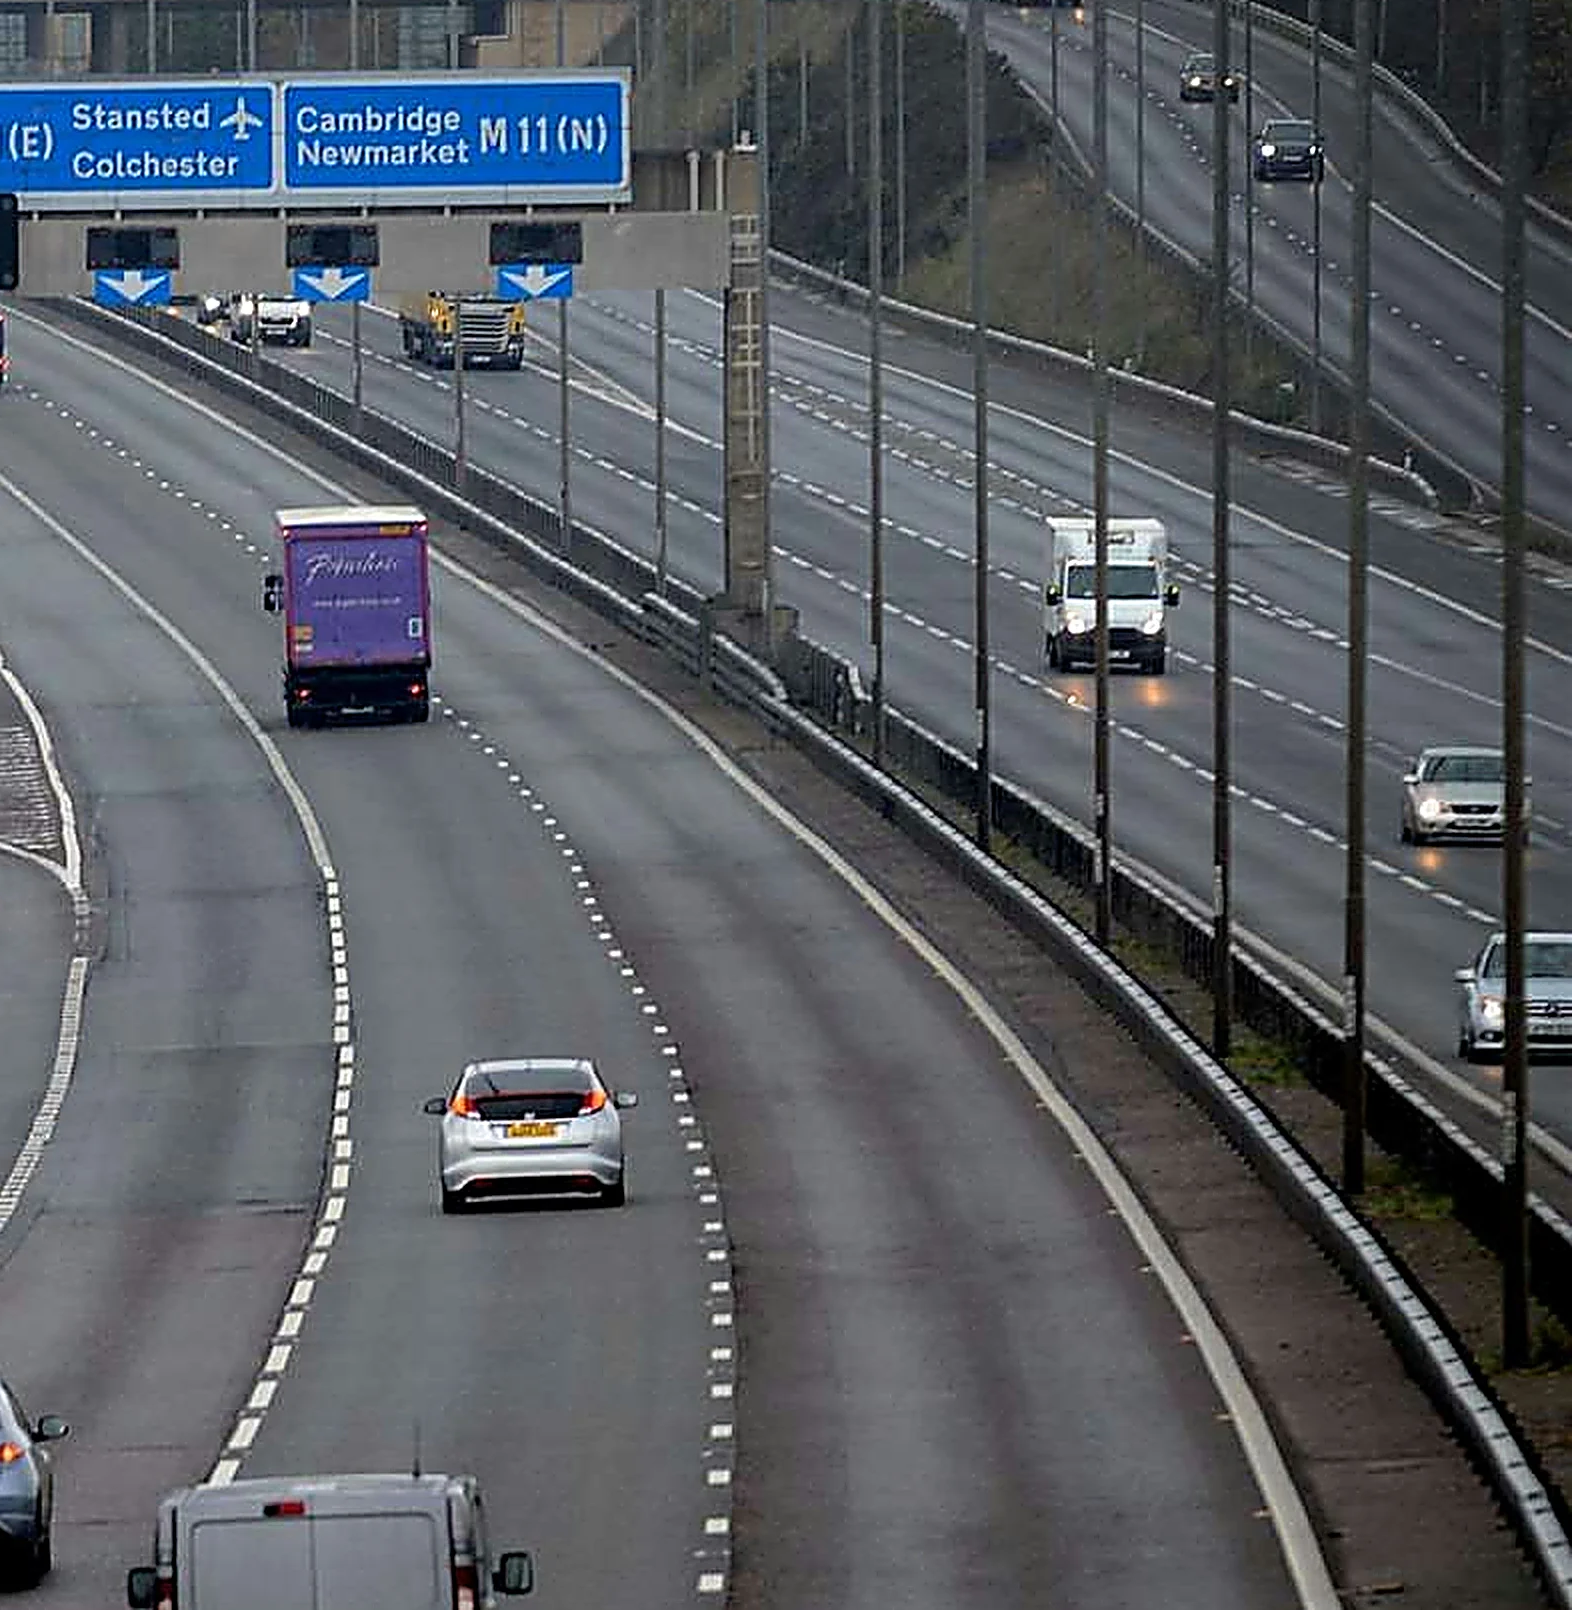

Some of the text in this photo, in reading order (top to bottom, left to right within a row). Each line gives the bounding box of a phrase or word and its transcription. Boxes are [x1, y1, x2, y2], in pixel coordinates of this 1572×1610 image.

[73, 103, 210, 130] Stansted
[297, 106, 461, 136] Cambridge
[73, 151, 238, 178] Colchester
[297, 139, 469, 166] Newmarket
